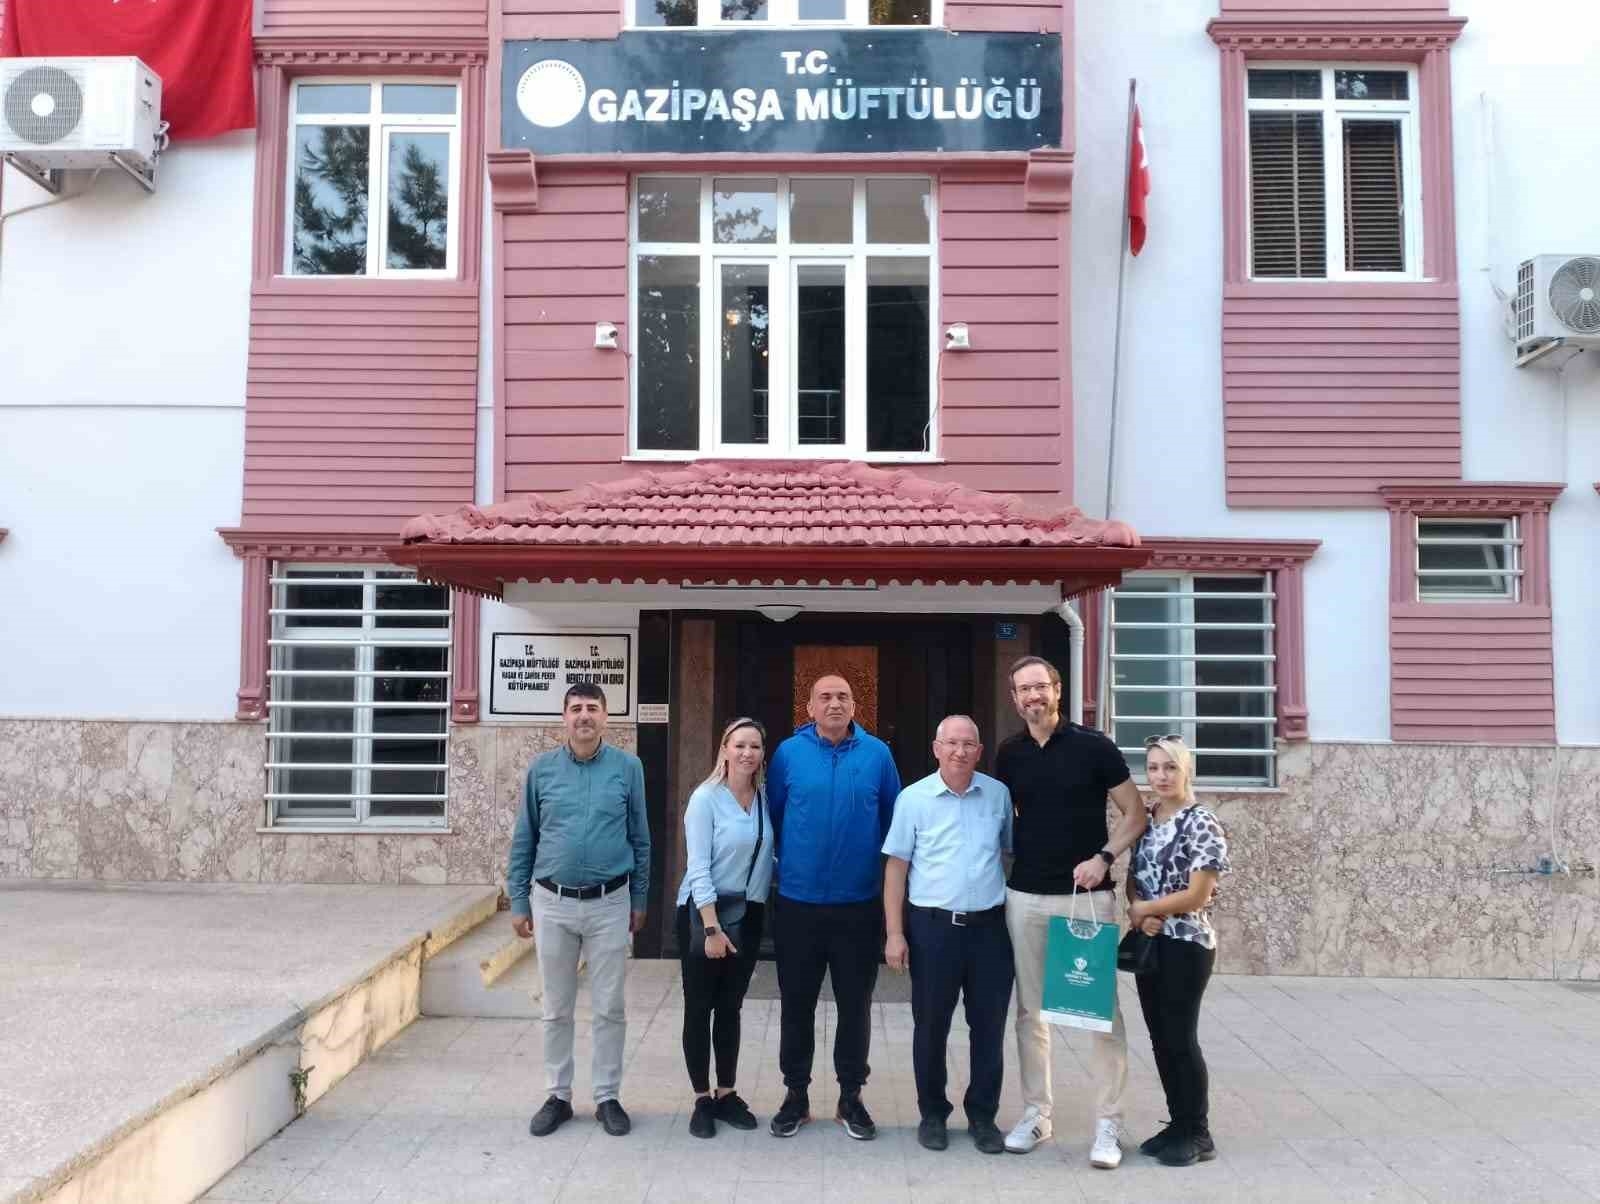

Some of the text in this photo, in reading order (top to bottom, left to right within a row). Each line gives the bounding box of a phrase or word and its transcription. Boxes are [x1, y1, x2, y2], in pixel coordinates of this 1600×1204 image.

[780, 50, 836, 74] T.C.
[587, 77, 1041, 132] GAZİPAŞA MÜFTÜLÜĞÜ
[500, 656, 559, 670] GAZİPAŞA MÜFTÜLÜĞÜ
[565, 657, 624, 671] GAZİPAŞA MÜFTÜLÜĞÜ
[508, 679, 550, 691] KÜTÜPHANESİ
